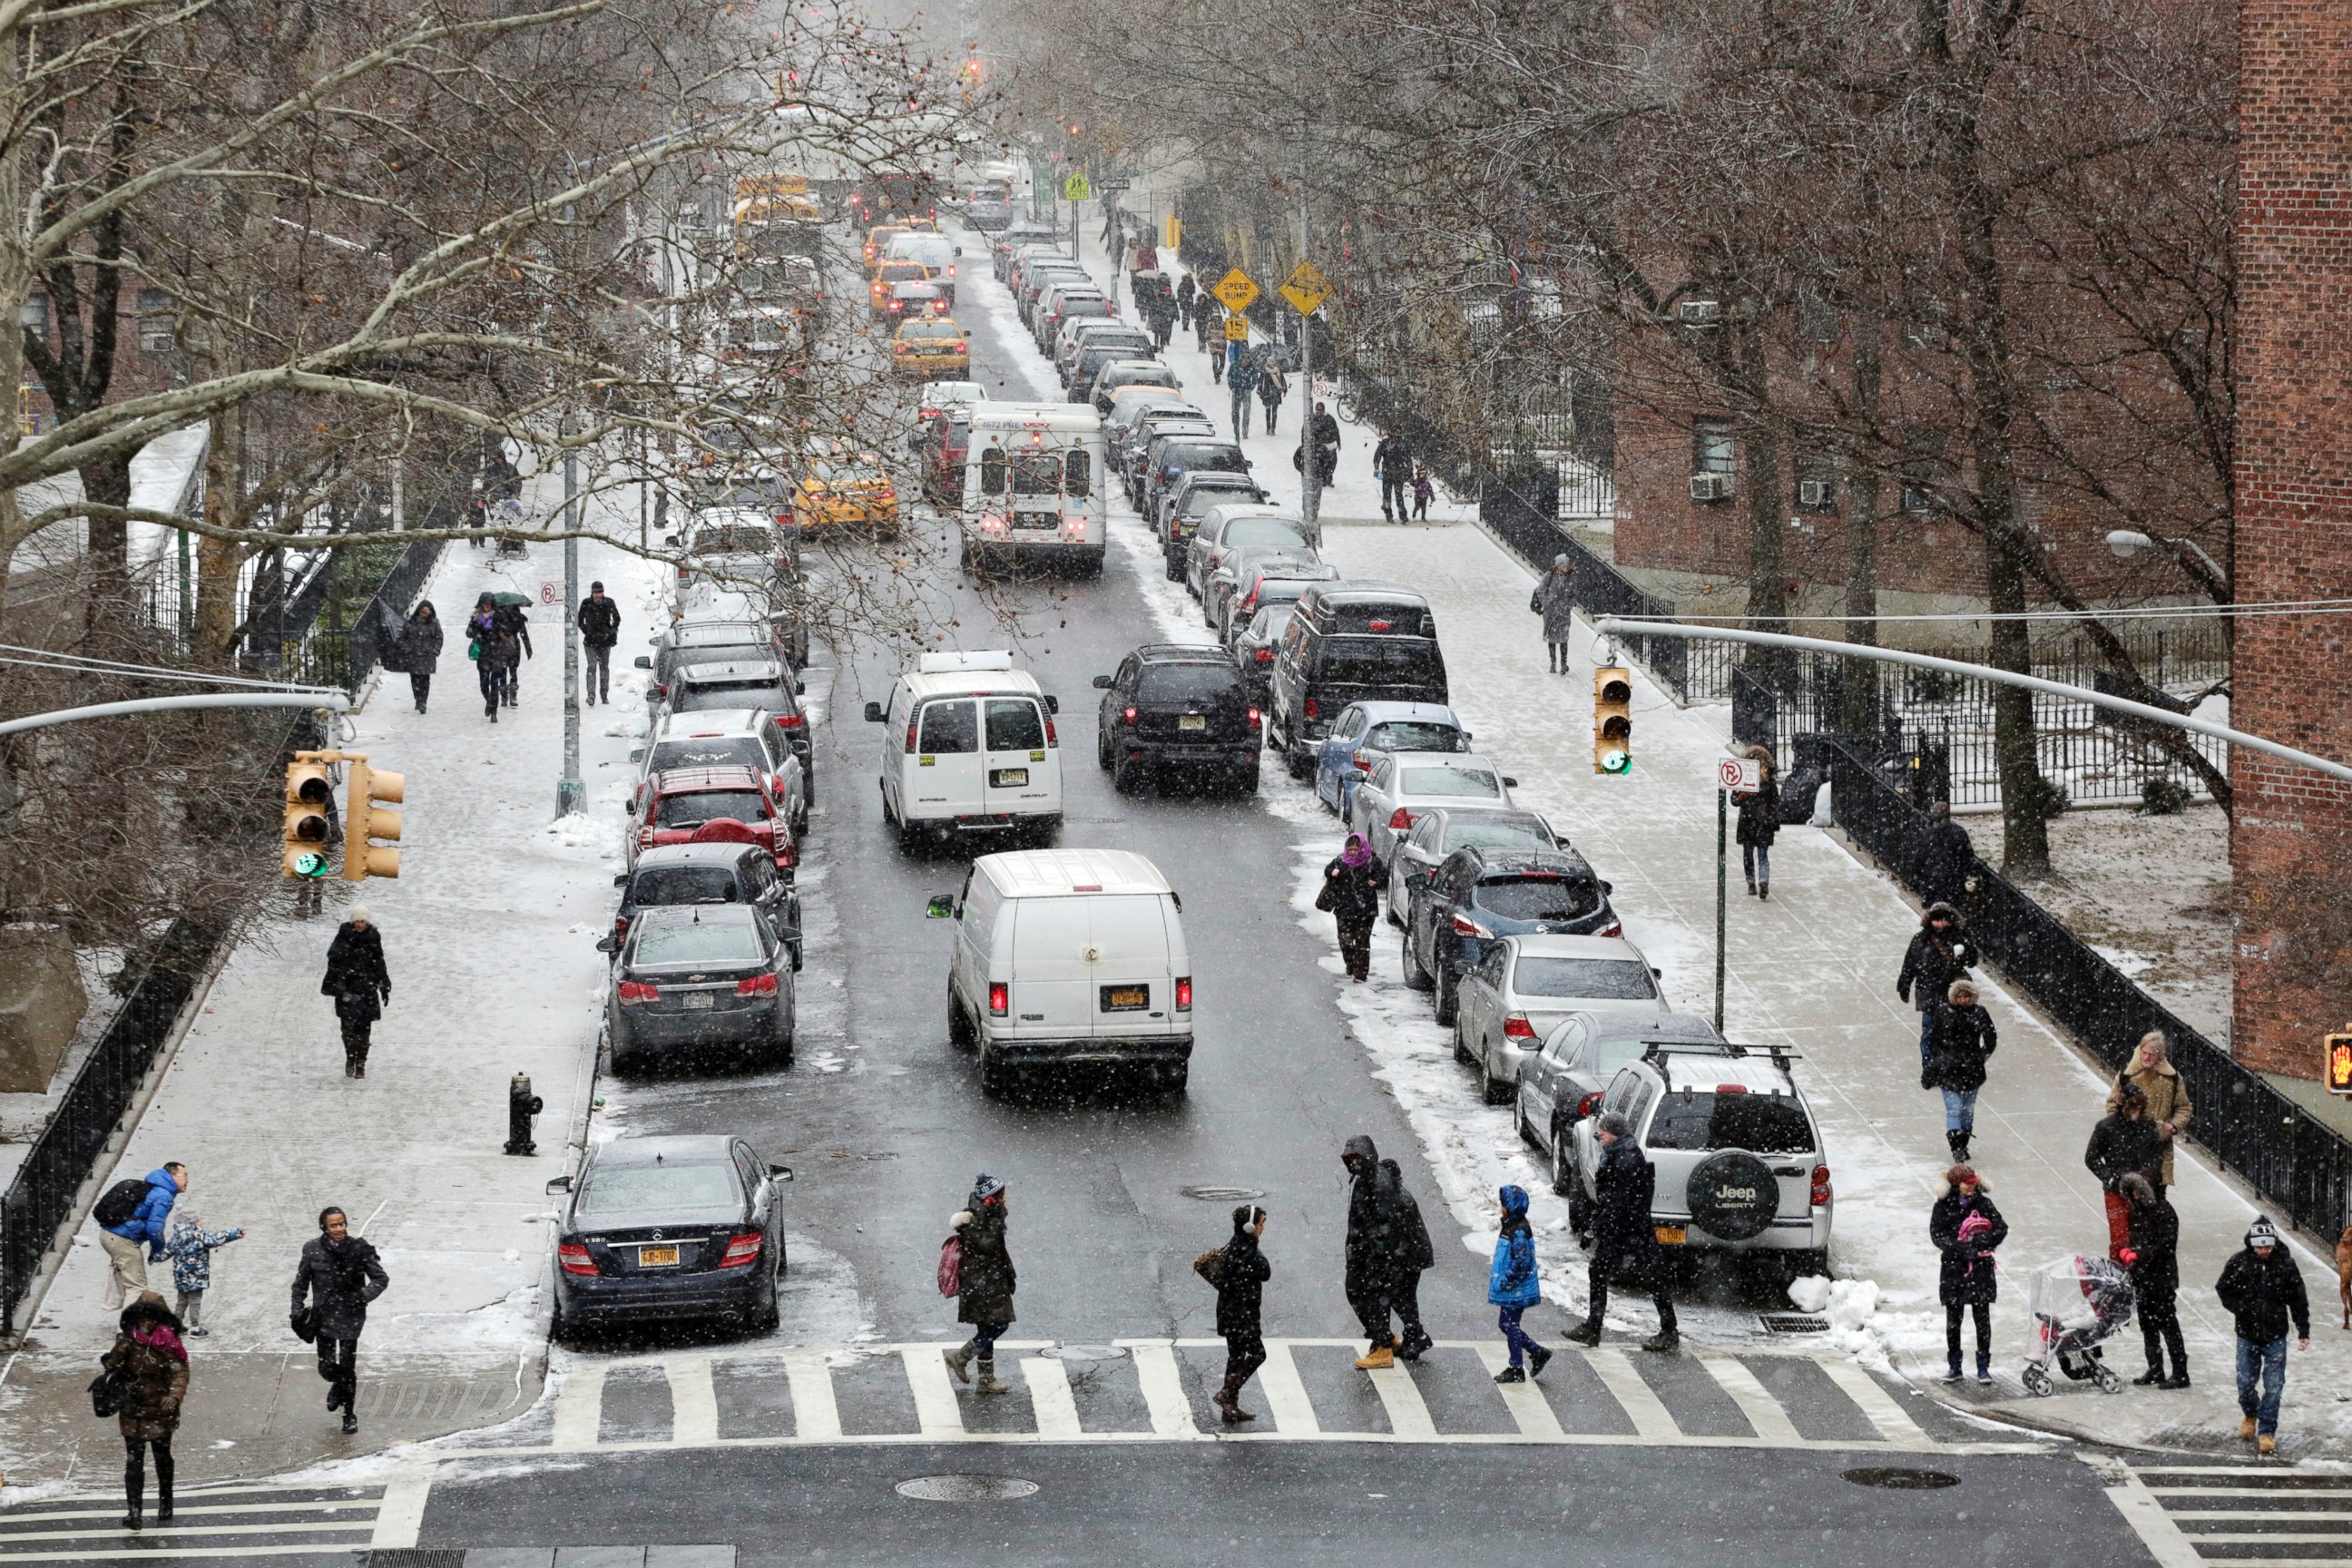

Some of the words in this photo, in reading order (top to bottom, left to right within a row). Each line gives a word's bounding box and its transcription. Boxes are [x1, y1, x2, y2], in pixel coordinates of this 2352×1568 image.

[1223, 282, 1250, 290] SPEED
[1229, 320, 1243, 331] 15
[982, 421, 1001, 429] 4672
[1716, 1184, 1756, 1200] Jeep
